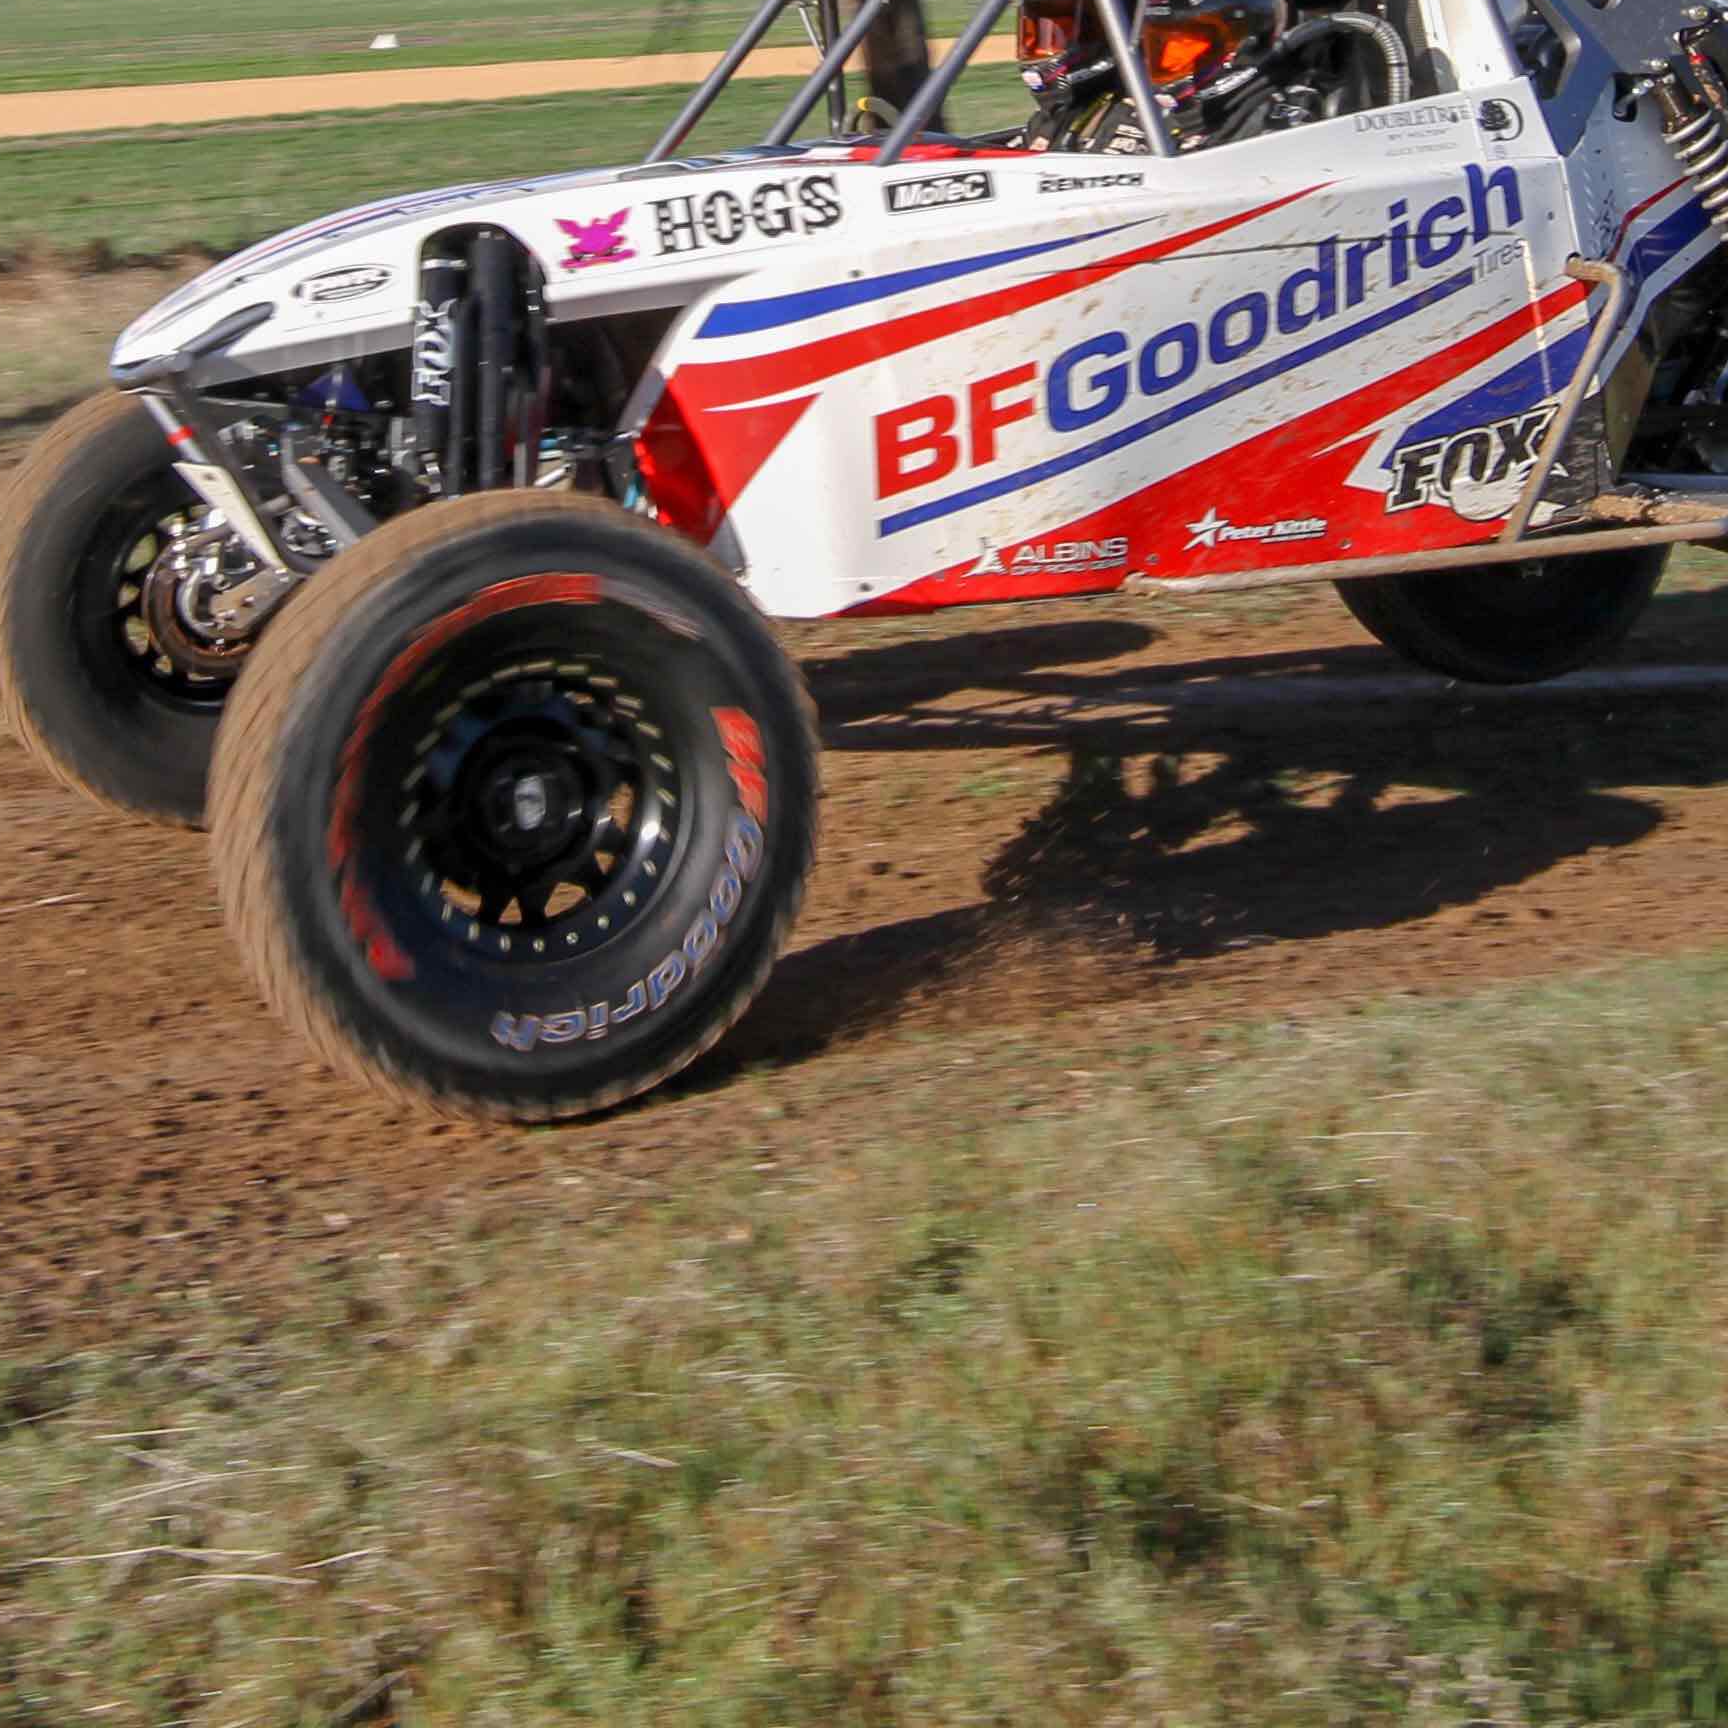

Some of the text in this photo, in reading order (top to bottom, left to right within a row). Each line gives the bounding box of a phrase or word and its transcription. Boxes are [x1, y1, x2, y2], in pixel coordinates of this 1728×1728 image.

[891, 171, 987, 210] MoTeC
[1037, 172, 1145, 194] RENTSCH
[645, 172, 843, 257] HOGS
[875, 162, 1523, 501] BFGoodrich
[1384, 402, 1564, 518] FOX
[1011, 536, 1129, 565] ALBINS
